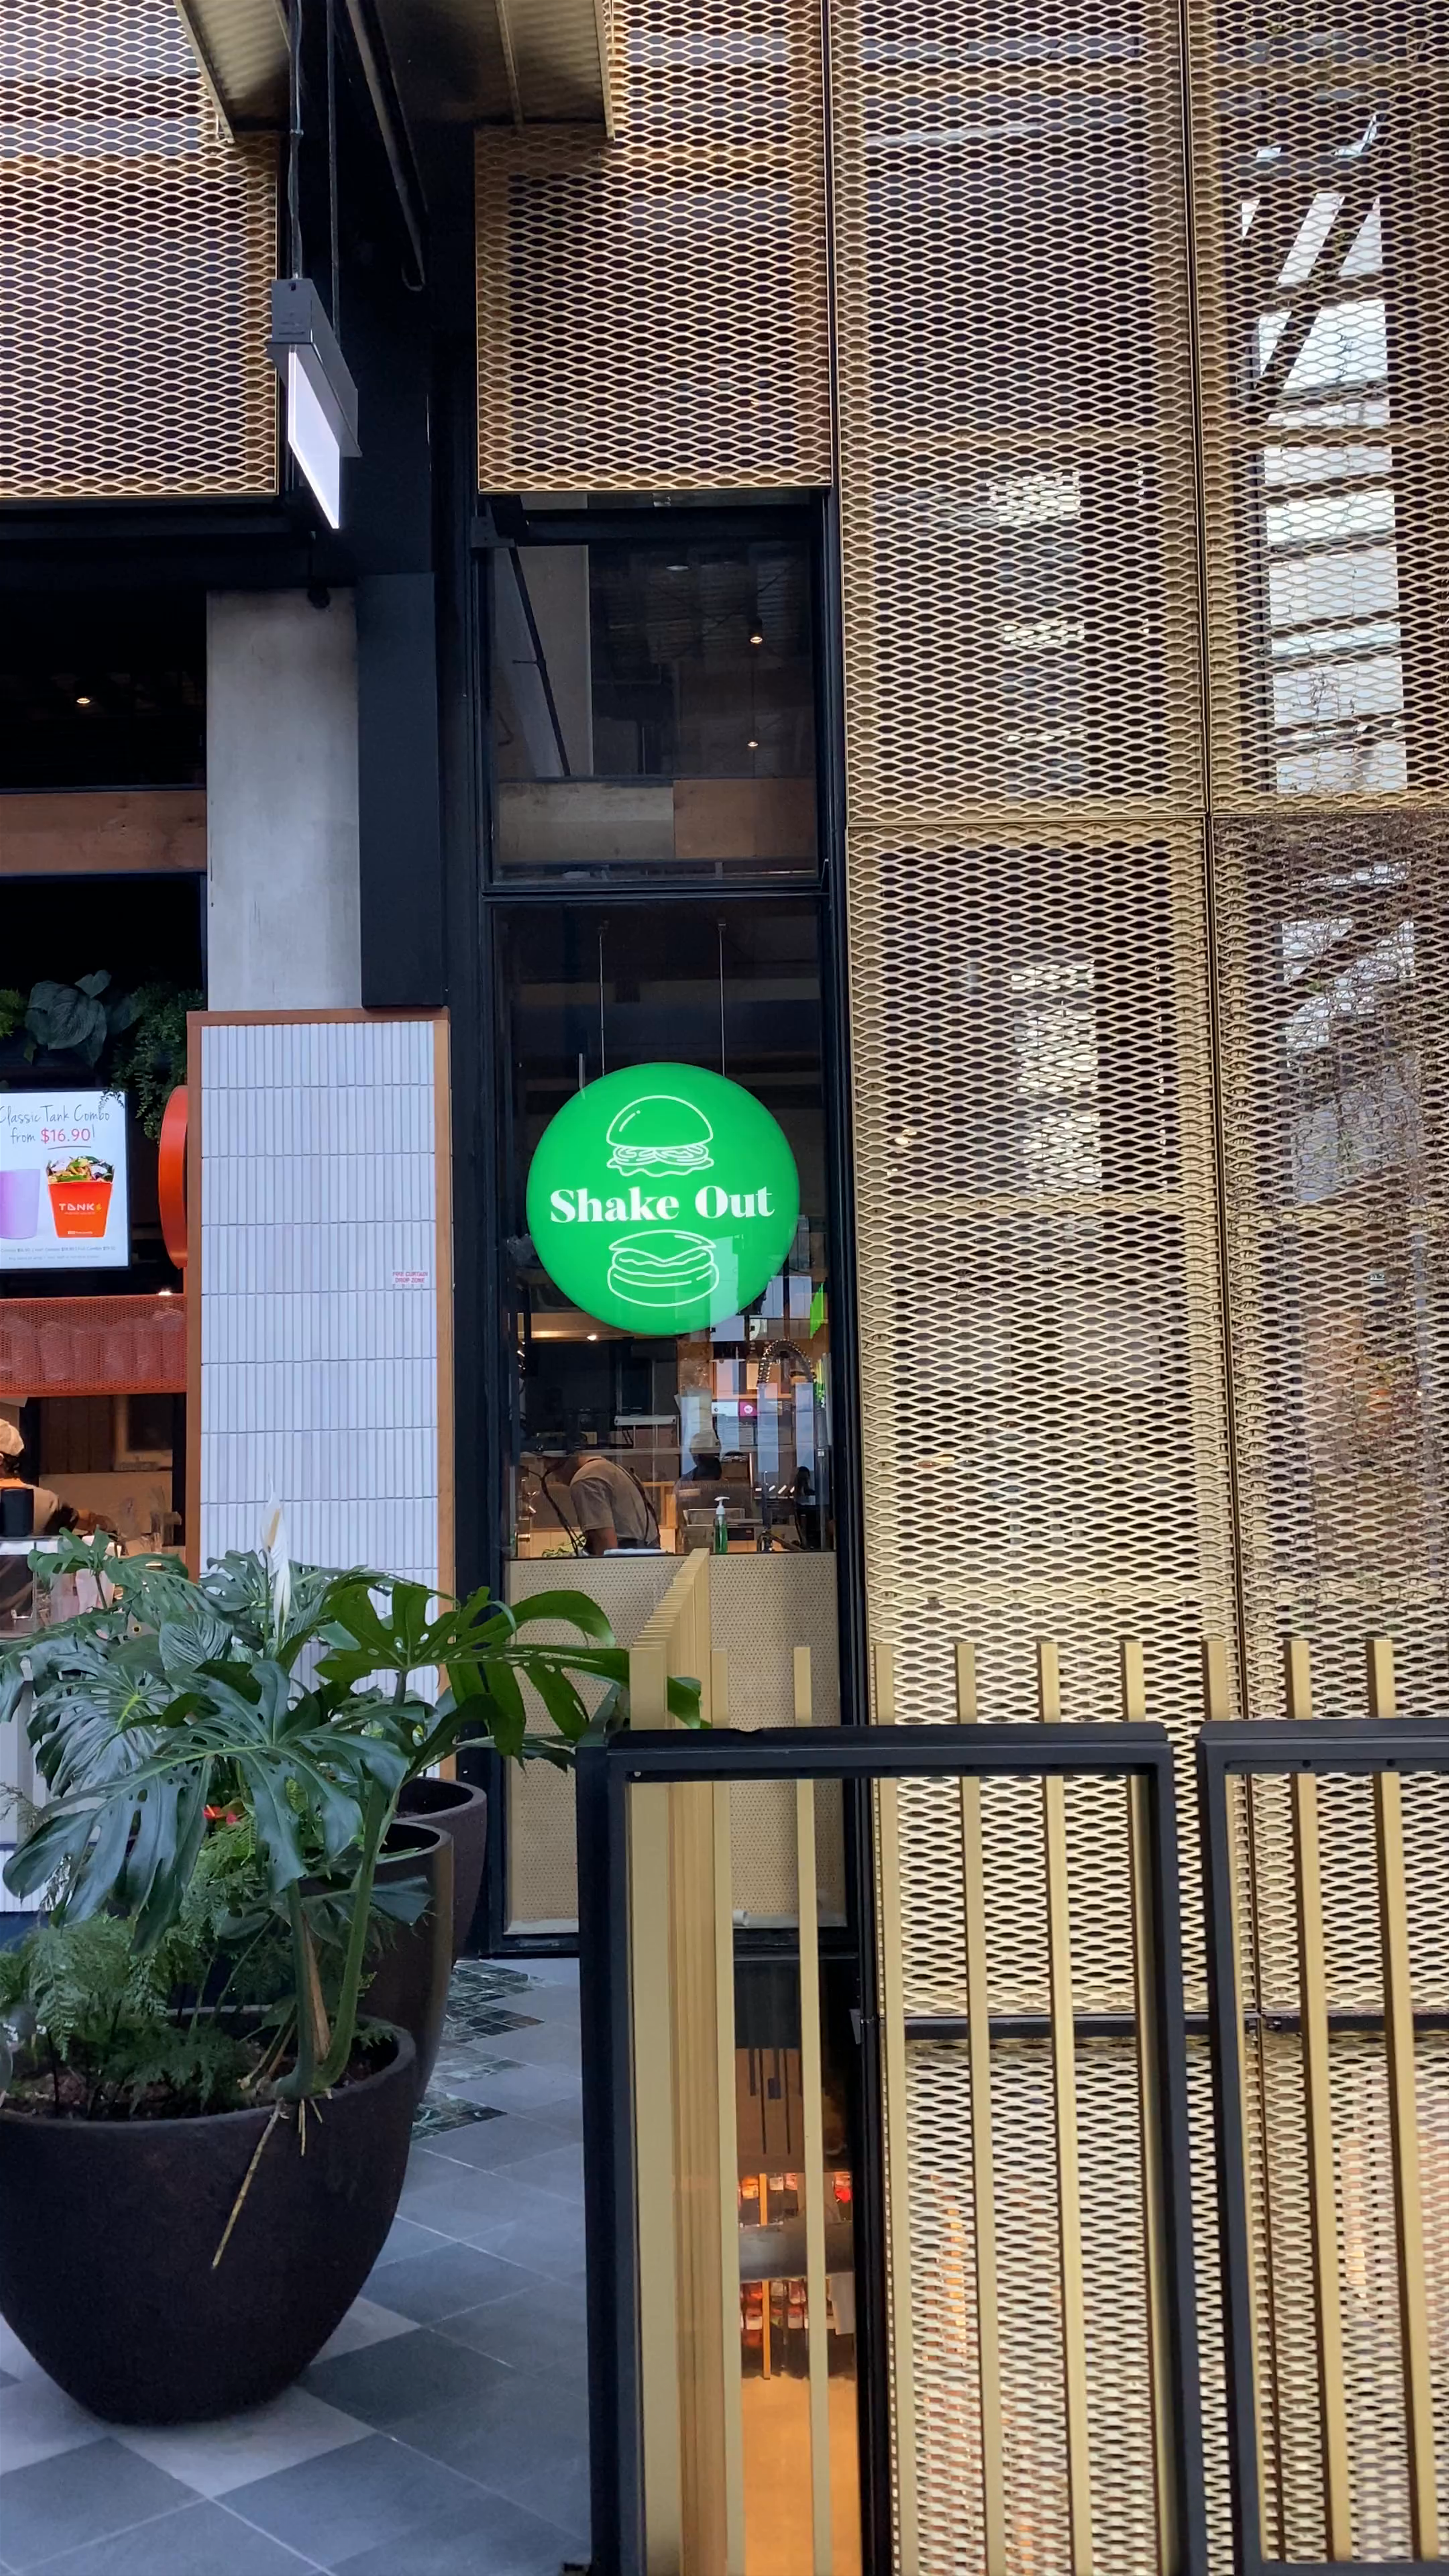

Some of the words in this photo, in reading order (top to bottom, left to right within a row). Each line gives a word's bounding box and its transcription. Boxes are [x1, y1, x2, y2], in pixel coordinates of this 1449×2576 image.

[0, 1106, 41, 1126] Classic
[40, 1105, 69, 1122] Tank
[74, 1104, 110, 1121] Combo
[11, 1127, 35, 1144] from
[550, 1186, 679, 1223] Shake
[695, 1185, 775, 1219] Out
